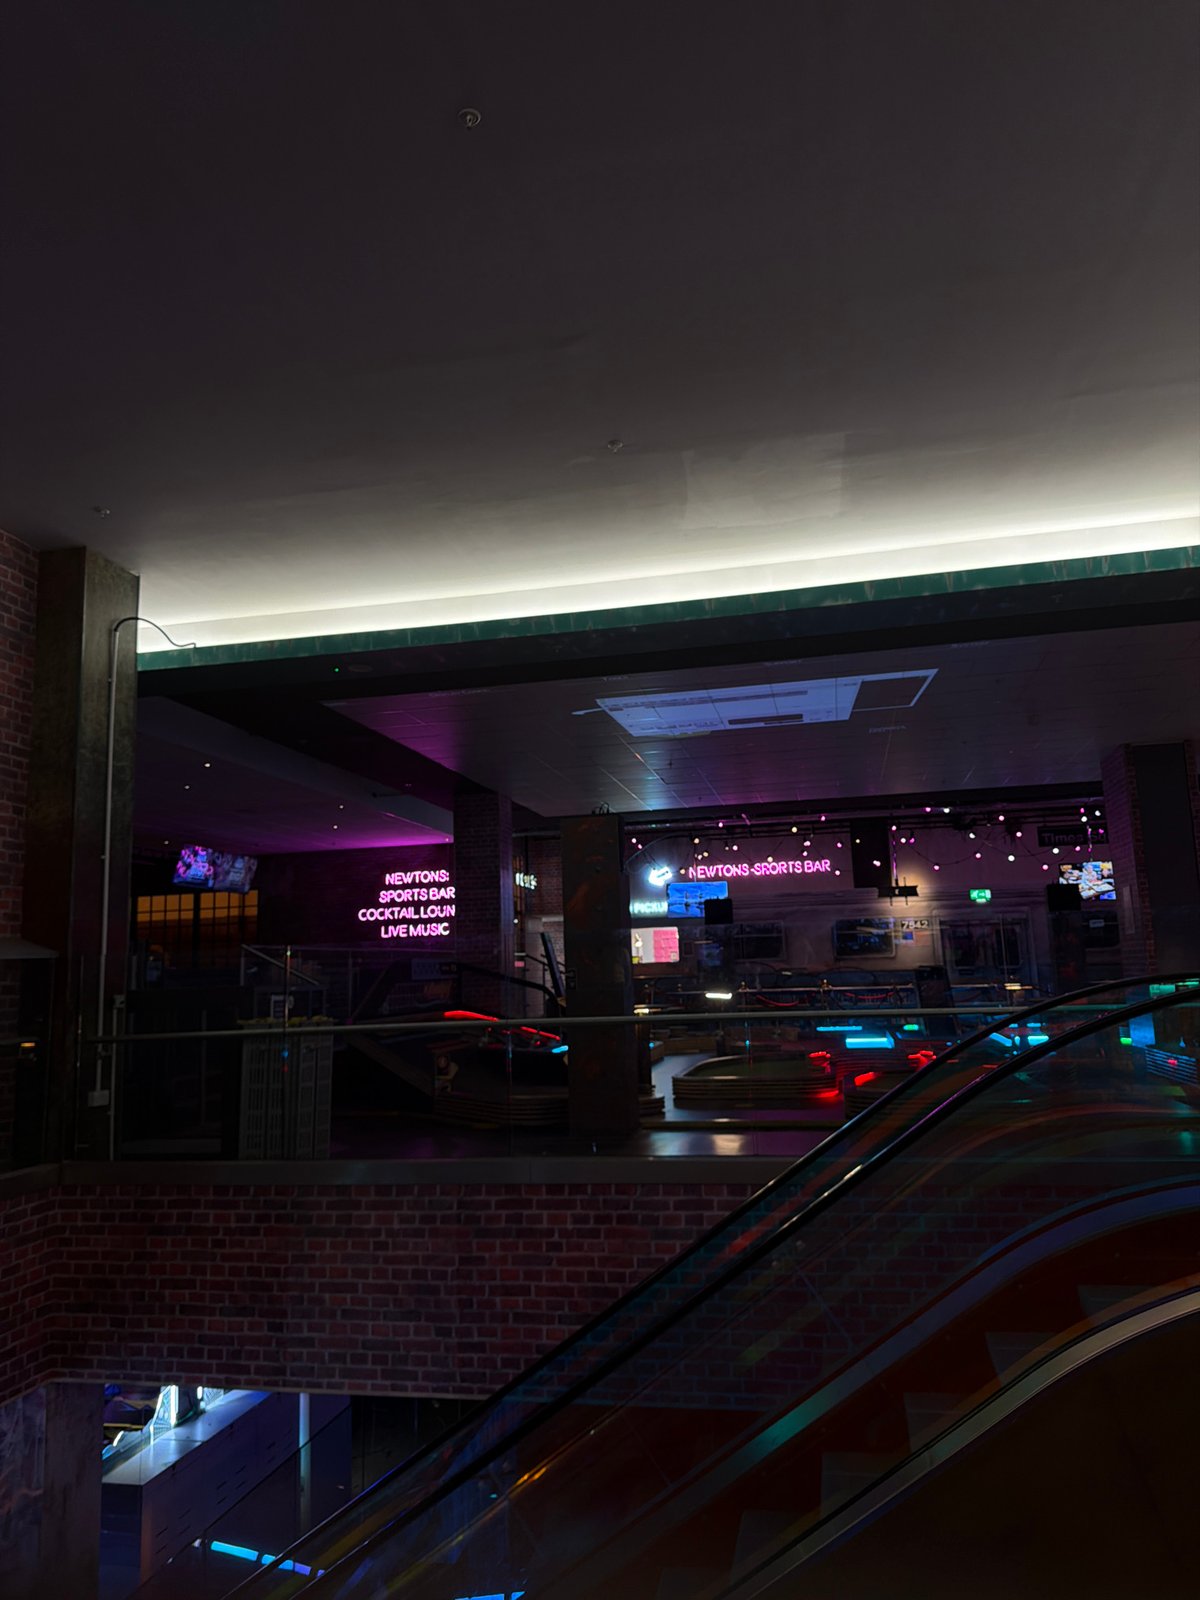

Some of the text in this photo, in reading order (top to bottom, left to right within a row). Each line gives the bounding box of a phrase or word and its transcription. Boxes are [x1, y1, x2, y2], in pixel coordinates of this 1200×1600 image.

[688, 860, 749, 879] NEWTONS
[804, 859, 831, 873] BAR
[378, 886, 456, 903] SPORTS BAR
[357, 906, 419, 921] COCKTAIL
[381, 922, 450, 938] LIVE MUSIC
